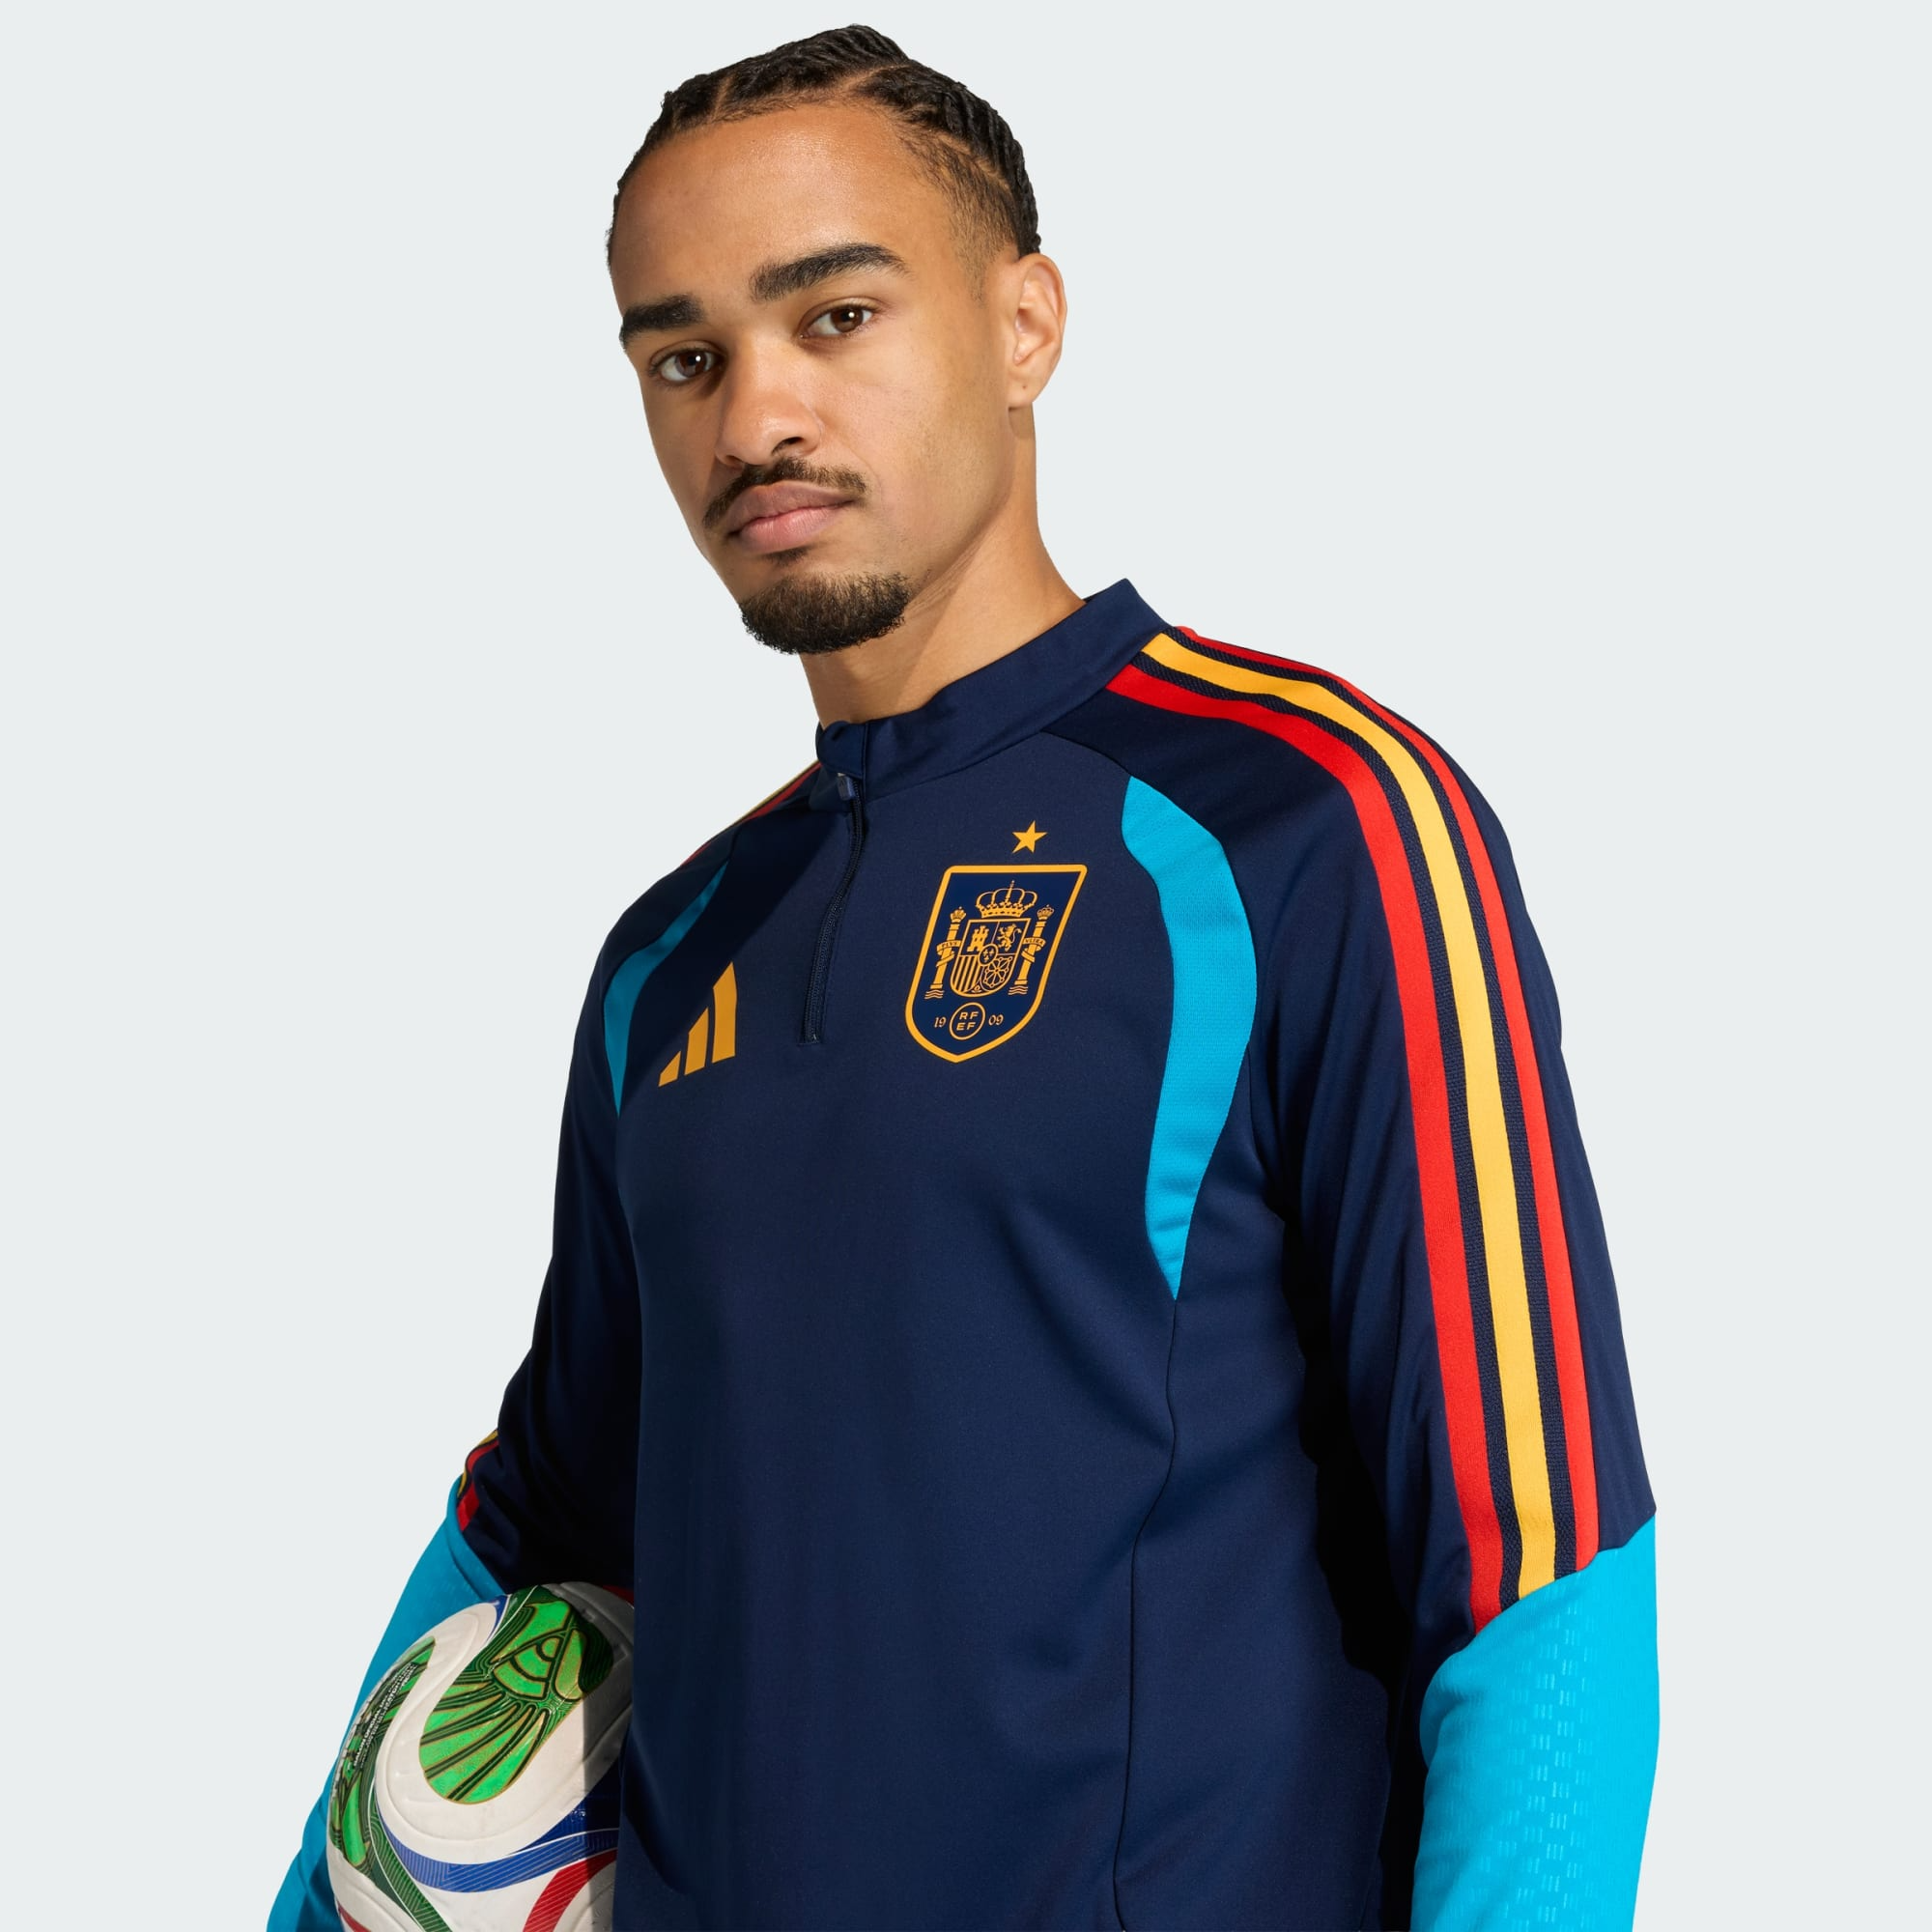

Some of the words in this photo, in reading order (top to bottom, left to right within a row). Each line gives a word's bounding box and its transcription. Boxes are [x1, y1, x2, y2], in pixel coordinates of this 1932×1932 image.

[959, 1011, 979, 1020] RF
[934, 1016, 947, 1028] 19
[988, 1014, 1004, 1026] 09
[956, 1022, 976, 1031] EF
